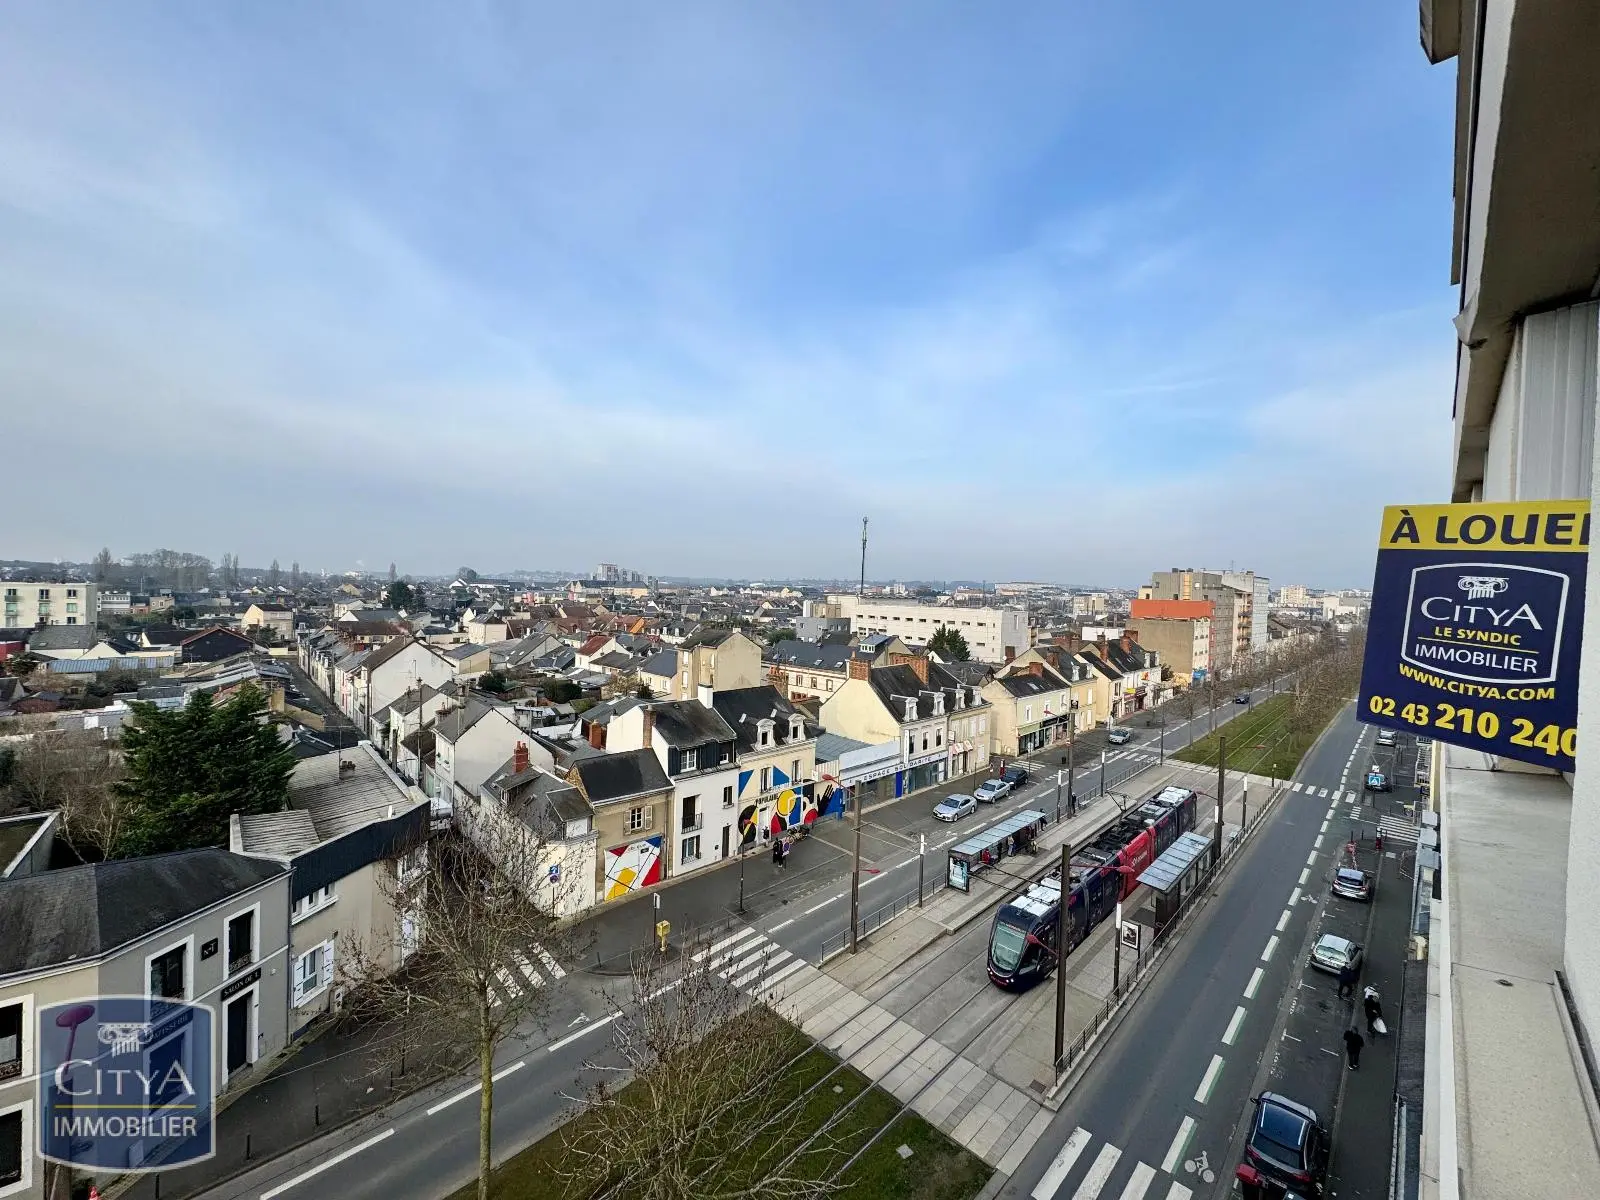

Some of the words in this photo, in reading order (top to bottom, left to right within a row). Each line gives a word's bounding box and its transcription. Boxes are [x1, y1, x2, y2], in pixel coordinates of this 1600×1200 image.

[1390, 509, 1420, 544] À
[1434, 626, 1452, 638] LE
[1457, 628, 1522, 646] SYNDIC
[1414, 643, 1538, 674] IMMOBILIER
[1399, 663, 1555, 701] WWW.CITYA.COM
[1369, 695, 1395, 717] 02
[1401, 702, 1430, 726] 43
[1435, 702, 1500, 739] 210
